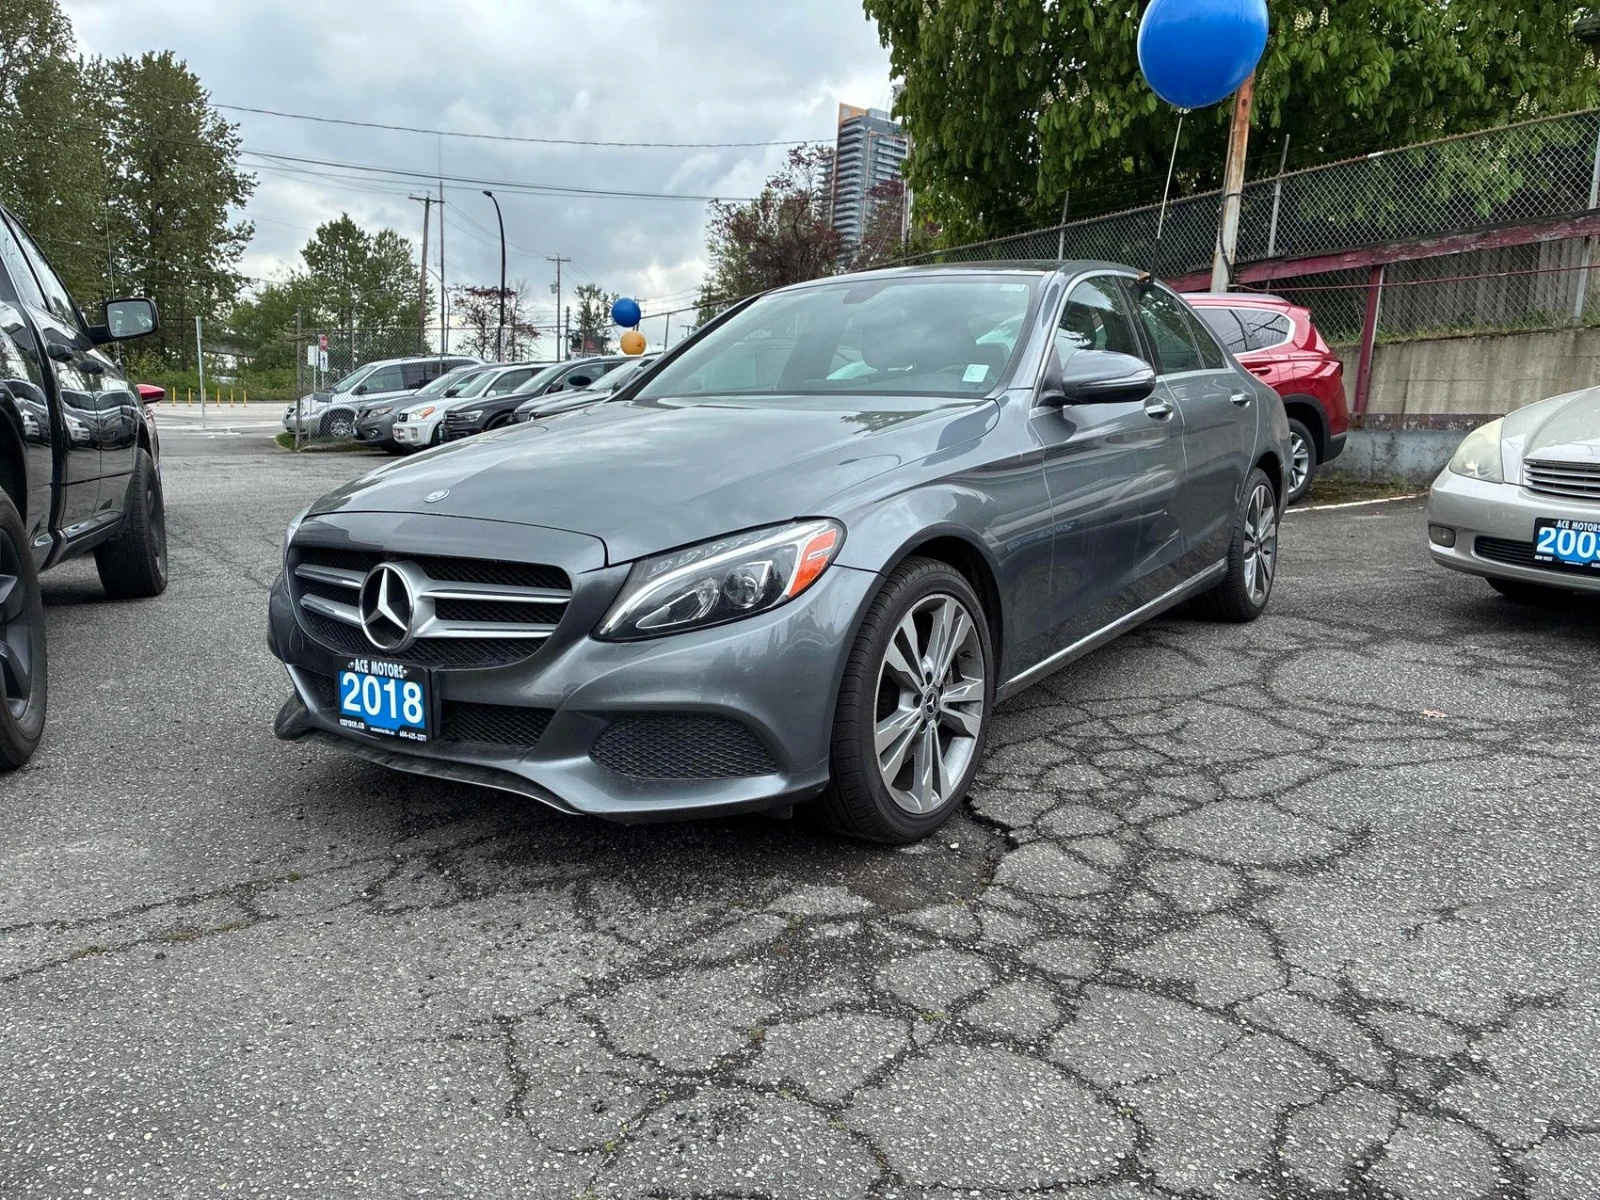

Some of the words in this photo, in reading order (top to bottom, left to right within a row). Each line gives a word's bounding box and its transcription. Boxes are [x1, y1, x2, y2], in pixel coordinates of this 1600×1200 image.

[1556, 520, 1570, 529] ACE
[354, 658, 369, 673] ACE
[371, 660, 404, 679] MOTORS
[342, 672, 423, 724] 2018
